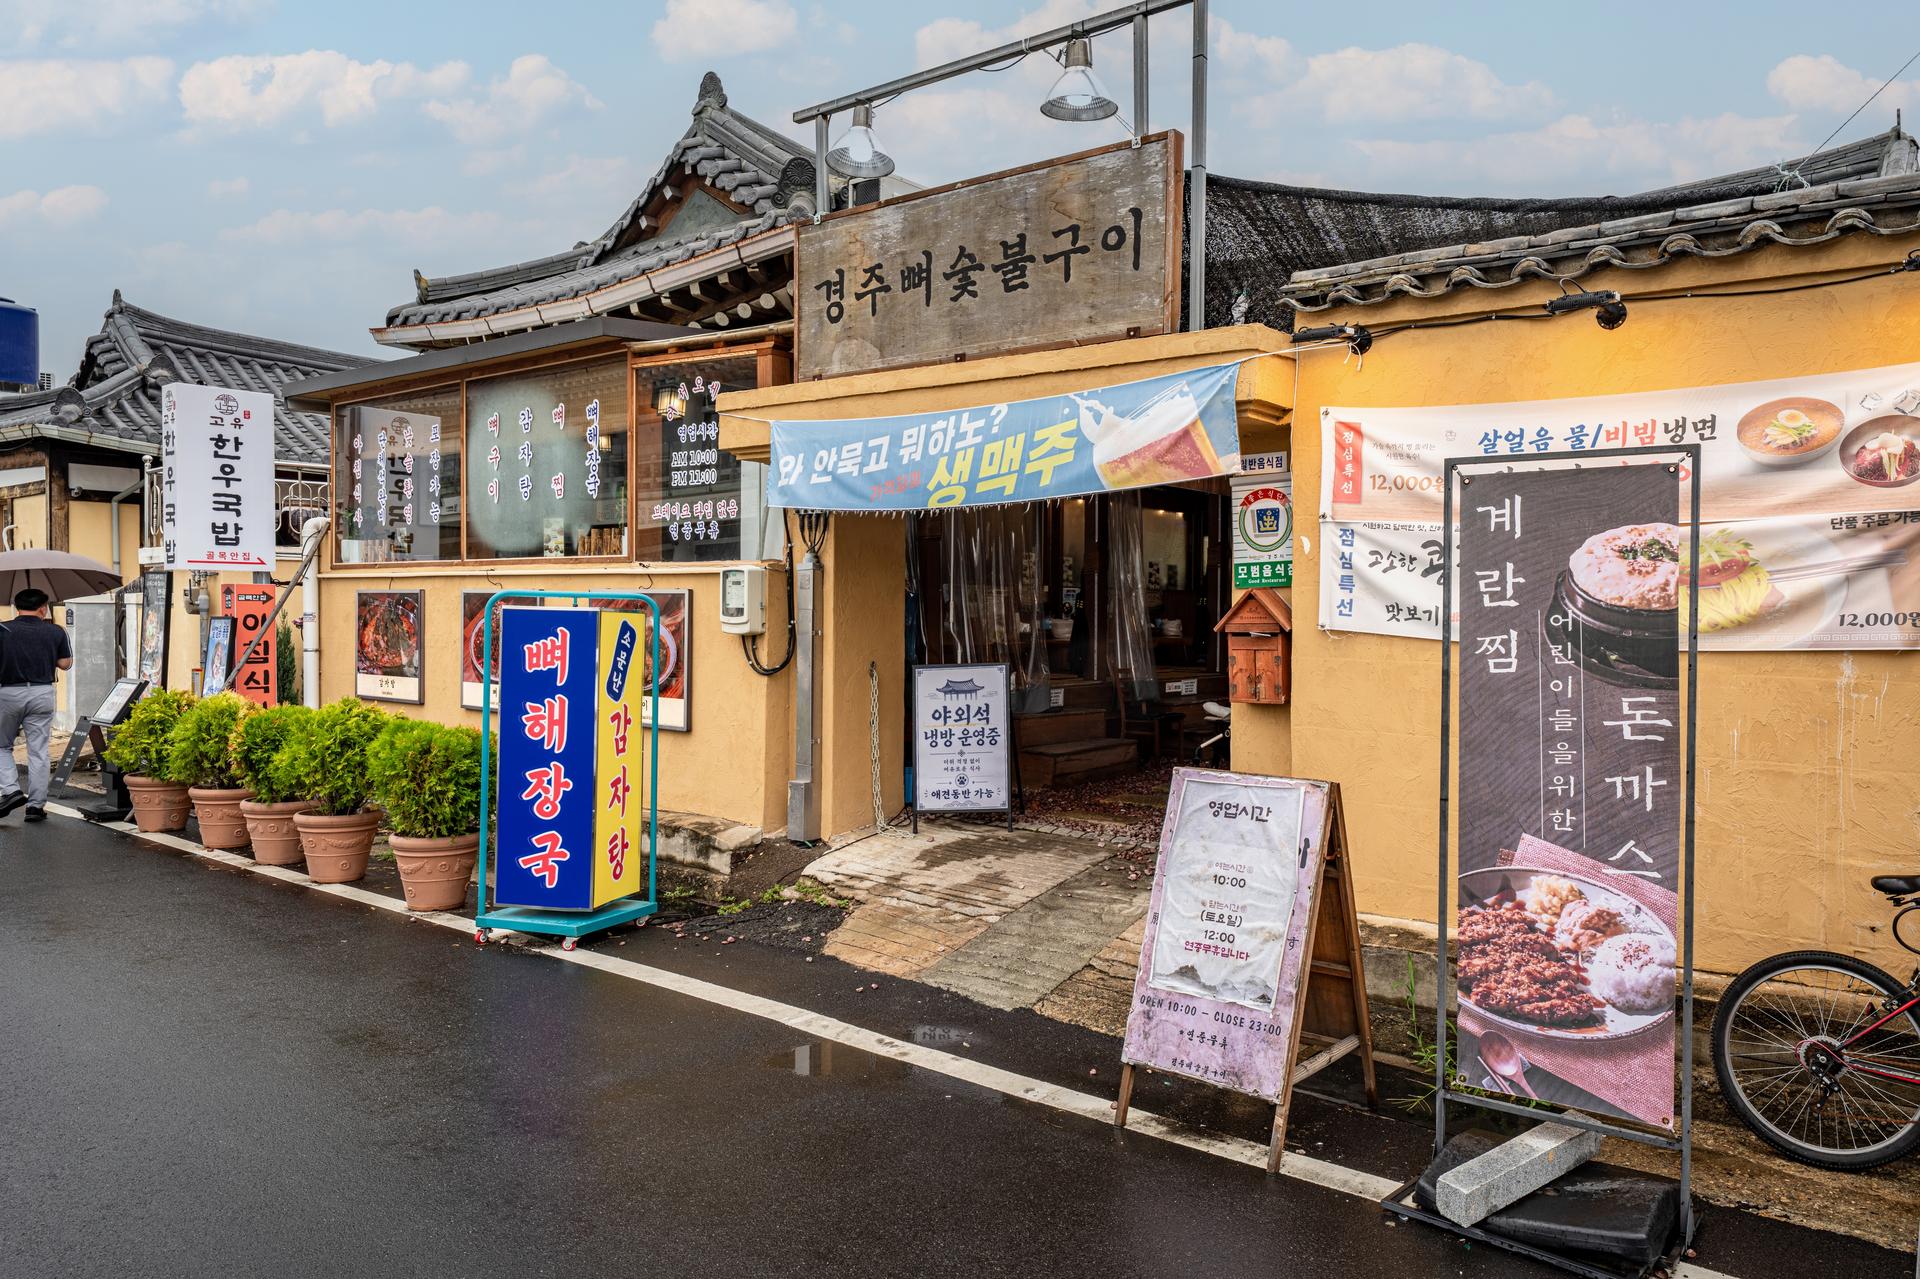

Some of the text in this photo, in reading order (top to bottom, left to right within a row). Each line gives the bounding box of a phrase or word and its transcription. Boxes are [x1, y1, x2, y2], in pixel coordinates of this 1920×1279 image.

[814, 207, 1143, 324] 경주뼈숯불구이
[209, 416, 244, 429] 고유
[677, 422, 719, 443] 영업시간
[586, 399, 600, 499] 뼈해장국
[778, 403, 1008, 487] 와 안묵고 뭐하노?
[1478, 426, 1554, 454] 살얼음
[488, 412, 500, 504] 뼈구이
[519, 407, 532, 500] 감자탕
[671, 449, 717, 467] AM 10:00
[927, 418, 1077, 507] 생맥주
[1241, 455, 1283, 471] 일반음식점
[353, 434, 363, 528] 아침식사
[430, 424, 440, 523] 포장가능
[671, 468, 717, 486] PM 11:00
[164, 430, 176, 563] 한우국밥
[209, 434, 244, 546] 한우국밥
[652, 500, 738, 521] 브레이크 타임 없음
[1830, 516, 1858, 530] 단품
[1862, 513, 1890, 528] 주문
[669, 521, 719, 540] 연중무휴
[206, 551, 251, 561] 골목안집
[1368, 551, 1417, 573] 고소한
[1336, 527, 1355, 618] 점심특선
[1475, 494, 1525, 674] 계란찜
[1385, 604, 1439, 626] 맛보기
[932, 703, 990, 725] 야외석
[924, 727, 1000, 748] 냉방 운영중
[519, 626, 572, 888] 뼈해장국
[608, 703, 632, 881] 감자탕
[931, 788, 994, 800] 애견동반 가능
[1602, 696, 1673, 879] 돈까스
[1209, 801, 1272, 822] 영업시간
[1213, 874, 1246, 888] 10:00
[1200, 910, 1243, 927] (토요일)
[1204, 930, 1235, 943] 12:00
[1184, 940, 1250, 961] 연중무휴입니다
[1139, 995, 1163, 1009] OPEN
[1168, 1001, 1197, 1016] 10:00
[1214, 1011, 1245, 1028] CLOSE
[1249, 1020, 1282, 1036] 23:00
[1186, 1029, 1228, 1050] 연중무휴
